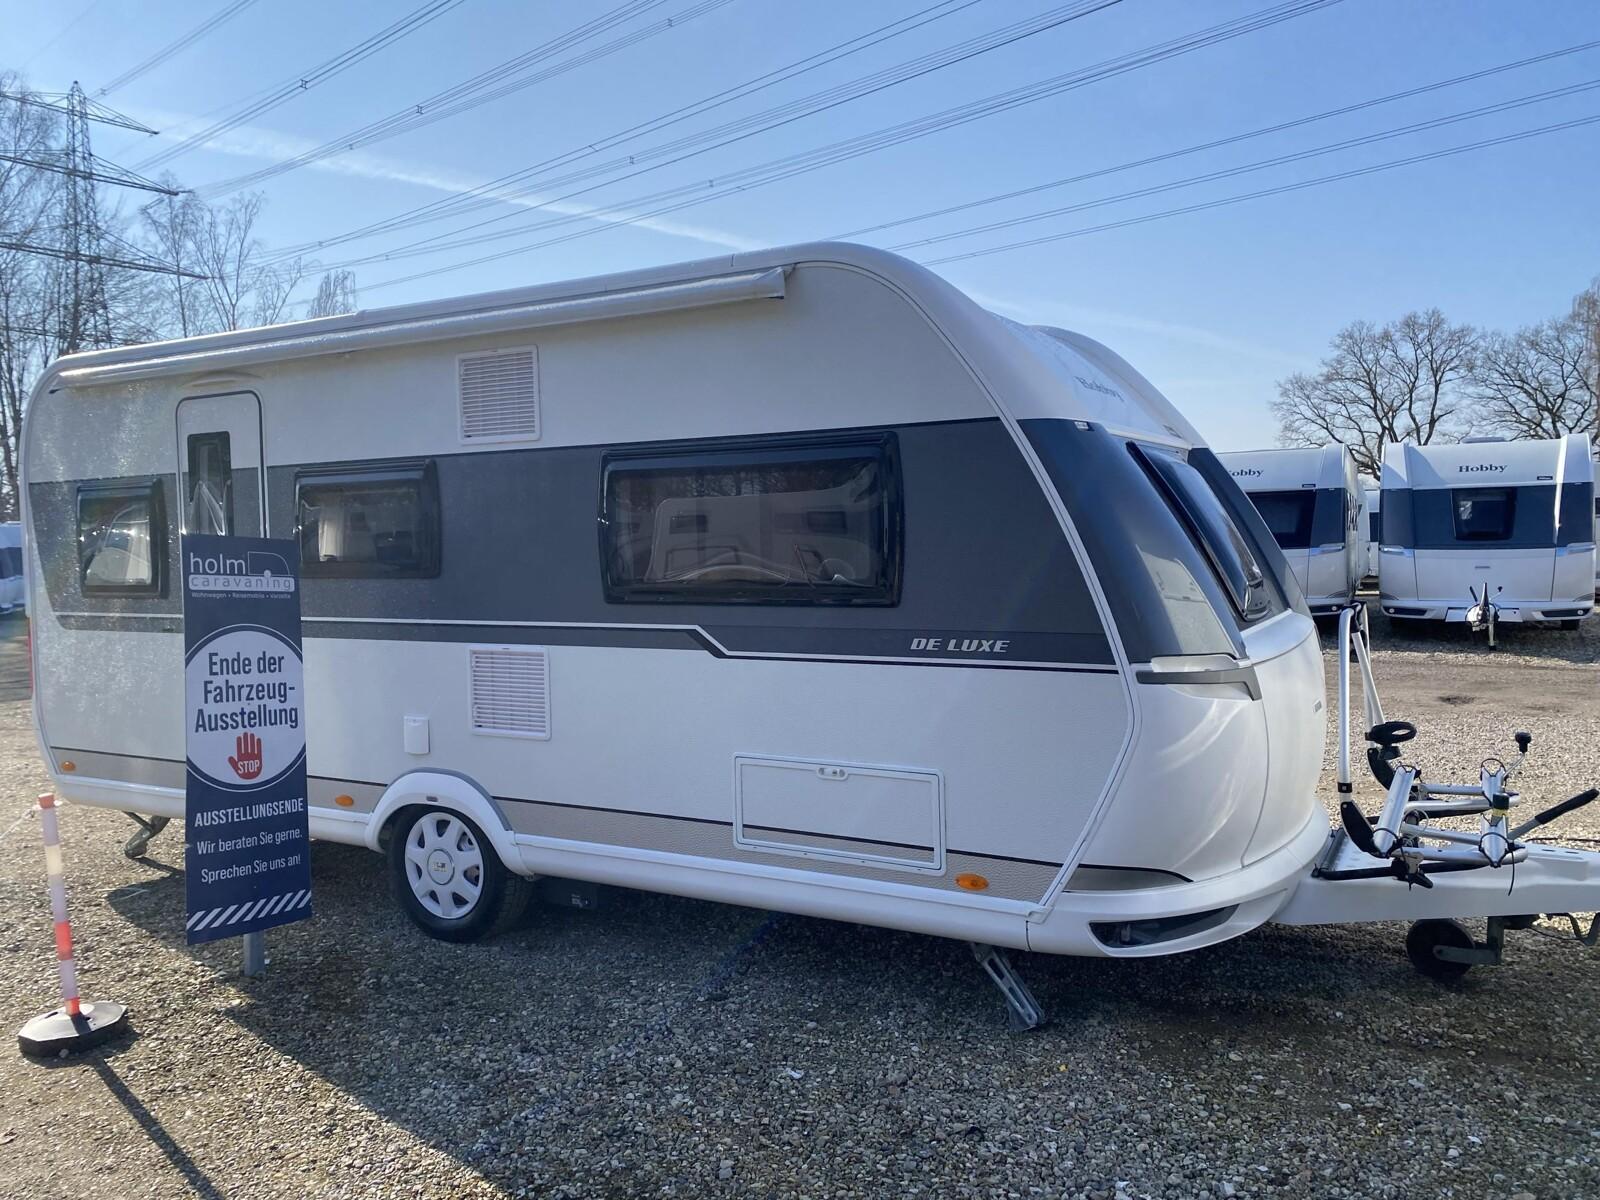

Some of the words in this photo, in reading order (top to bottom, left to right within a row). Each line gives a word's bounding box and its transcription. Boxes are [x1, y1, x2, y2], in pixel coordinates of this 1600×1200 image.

[1229, 468, 1264, 477] obby
[1458, 464, 1508, 473] Hobby
[190, 552, 246, 575] holm
[191, 575, 292, 591] caravaning
[910, 638, 942, 651] DE
[947, 639, 1010, 653] LUXE
[208, 651, 252, 676] Ende
[257, 651, 284, 674] der
[203, 680, 295, 704] Fahrzeug-
[195, 704, 299, 733] Ausstellung
[237, 760, 260, 774] STOP
[194, 797, 304, 827] AUSSTELLUNGSENDE
[197, 841, 216, 855] Wir
[218, 836, 258, 852] beraten
[259, 831, 273, 845] Sie
[275, 828, 303, 844] gerne.
[201, 864, 252, 884] Sprechen
[253, 859, 268, 873] Sie
[269, 857, 286, 870] uns
[287, 853, 301, 867] an!
